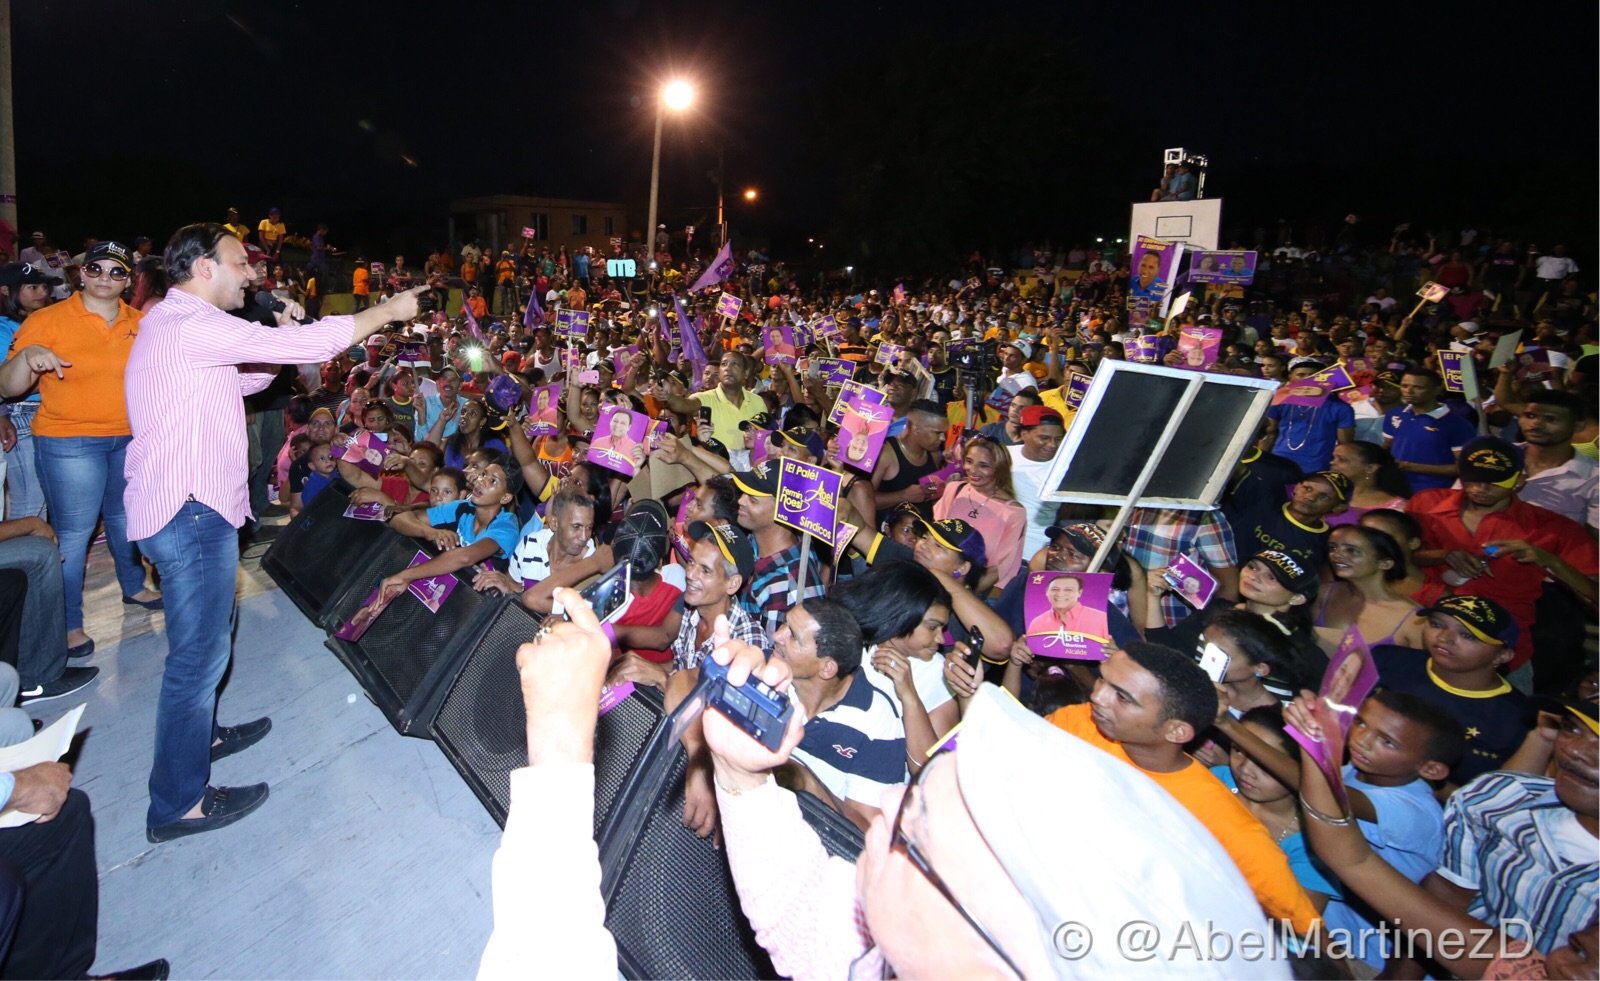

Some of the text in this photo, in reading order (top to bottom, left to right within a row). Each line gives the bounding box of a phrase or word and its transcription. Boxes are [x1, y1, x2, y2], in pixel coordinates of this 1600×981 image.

[785, 462, 819, 481] ¡El Palé!
[805, 480, 834, 504] Abel
[799, 515, 832, 540] Síndicos
[1043, 625, 1085, 648] Abel
